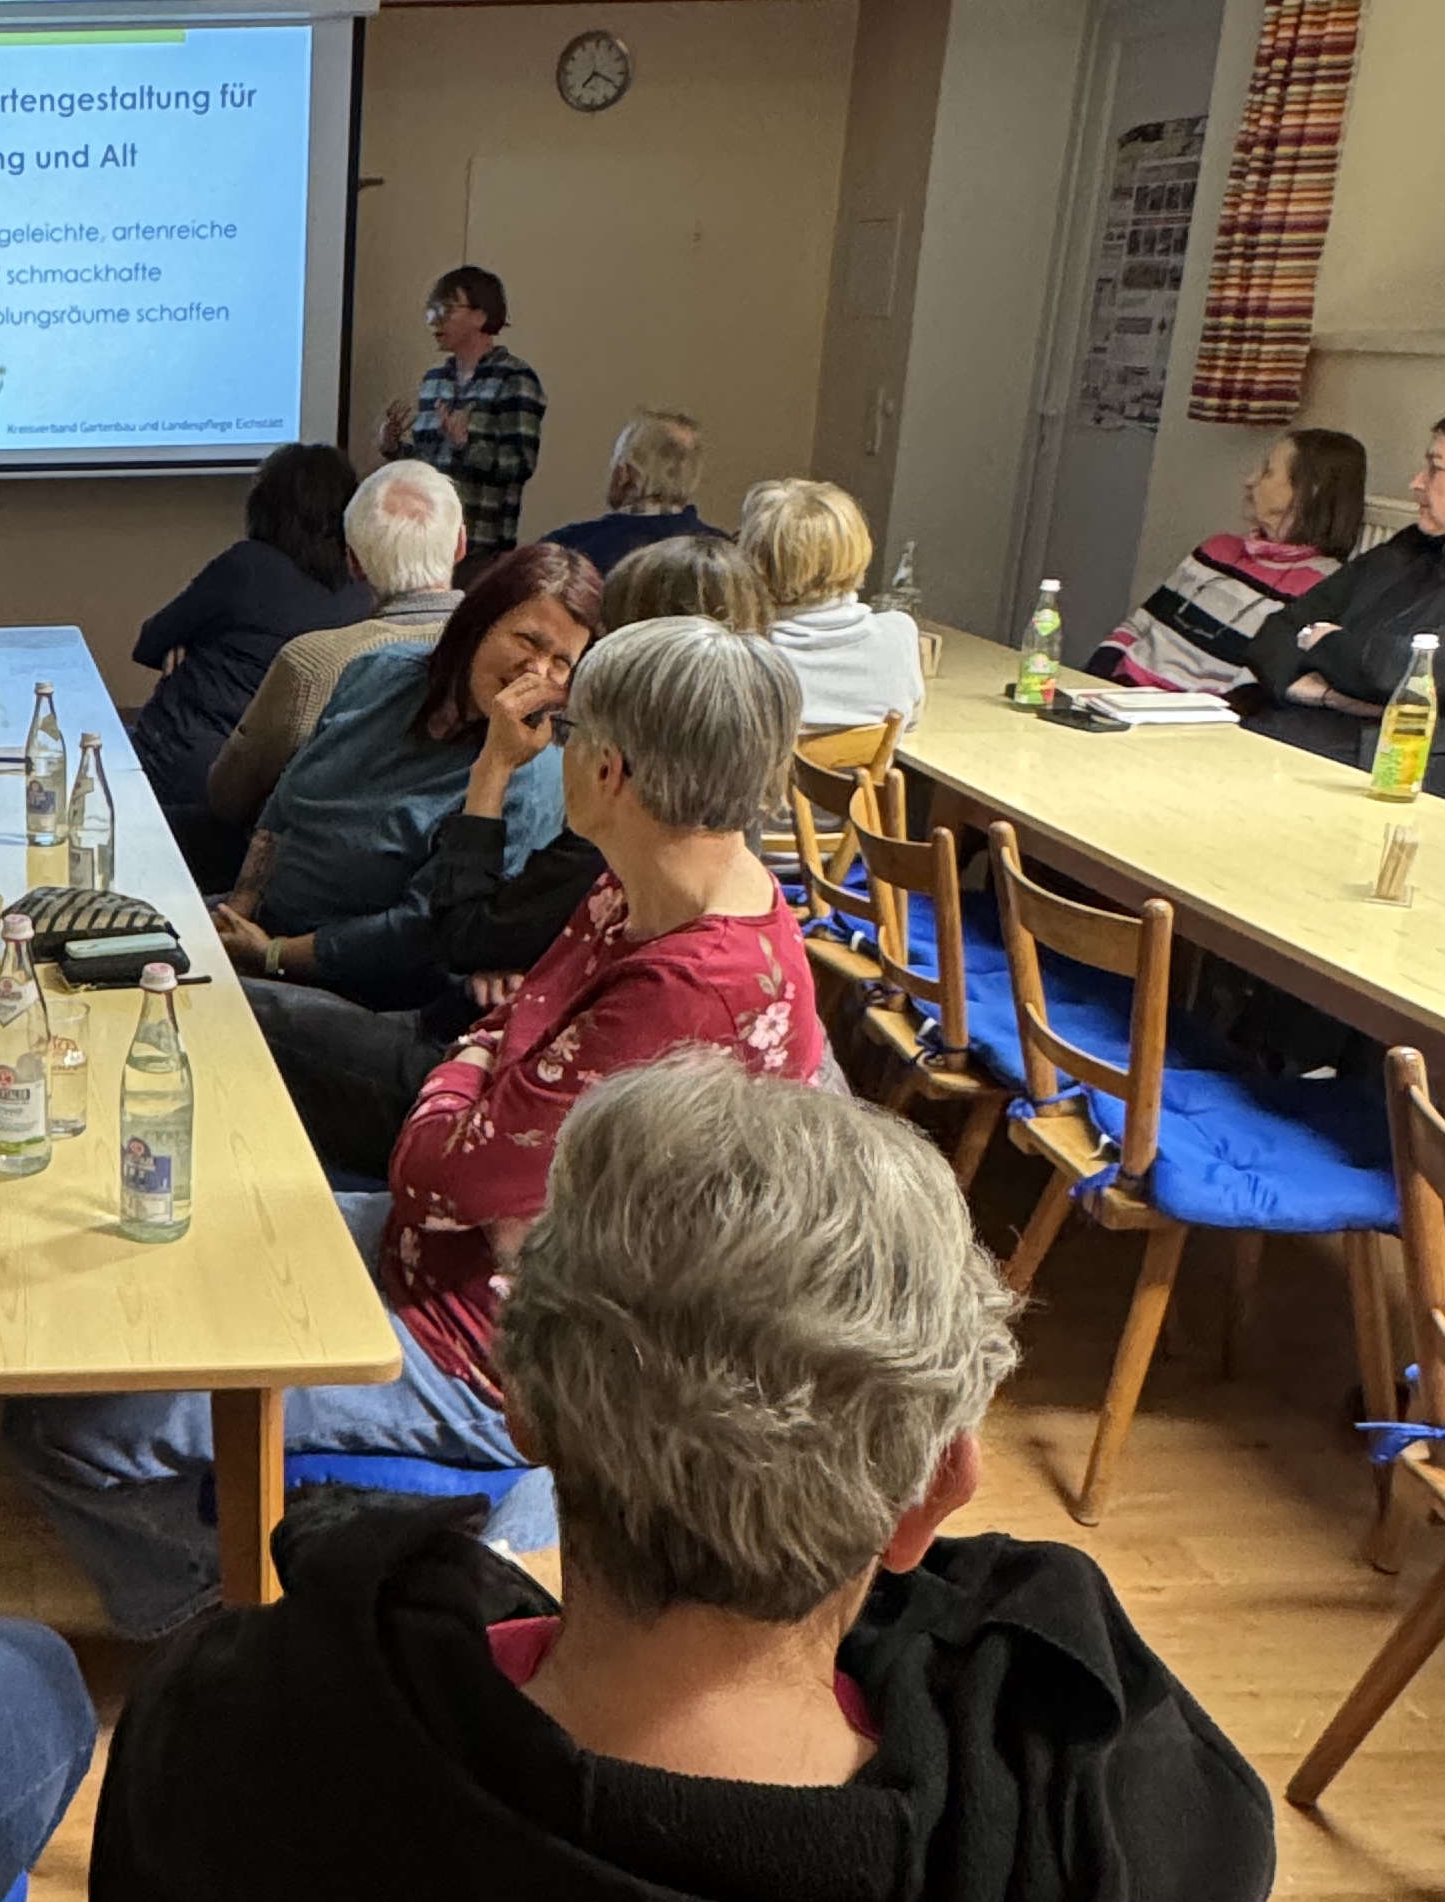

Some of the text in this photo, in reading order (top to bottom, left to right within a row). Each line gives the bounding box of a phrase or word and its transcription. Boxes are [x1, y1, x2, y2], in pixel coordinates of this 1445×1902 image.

[220, 82, 257, 108] für
[35, 144, 89, 169] und
[99, 143, 138, 168] Alt
[111, 220, 238, 242] artenreiche
[6, 263, 162, 285] schmackhafte
[136, 302, 230, 324] schaffen
[80, 420, 137, 433] Gartenbau
[138, 420, 160, 432] und
[161, 417, 233, 432] Landespflege
